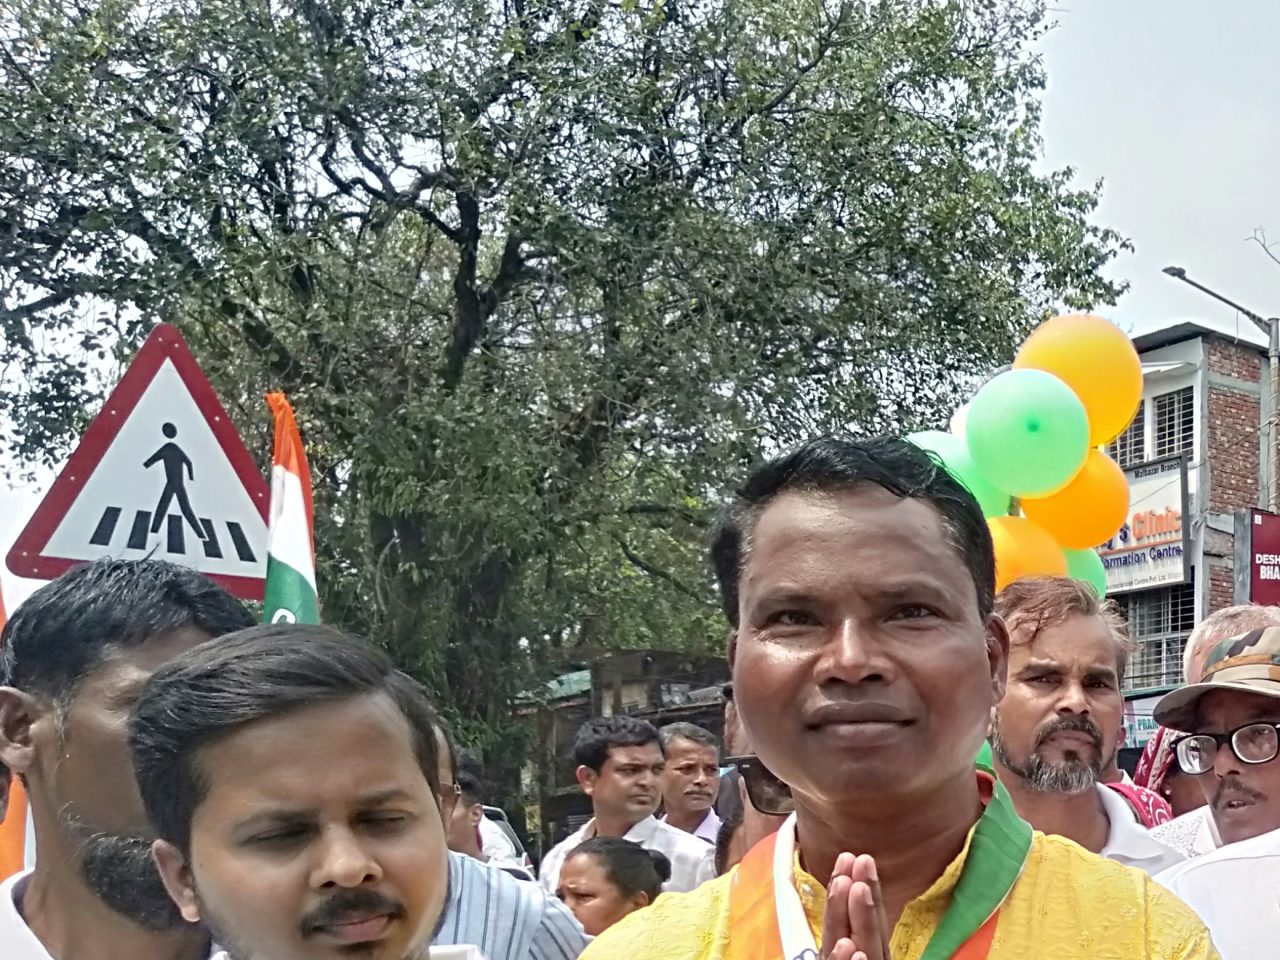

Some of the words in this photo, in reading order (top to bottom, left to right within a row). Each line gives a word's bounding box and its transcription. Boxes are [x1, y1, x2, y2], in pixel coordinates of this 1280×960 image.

[1161, 462, 1180, 472] Branch
[1132, 506, 1182, 541] Clinic
[1149, 544, 1182, 561] Centre
